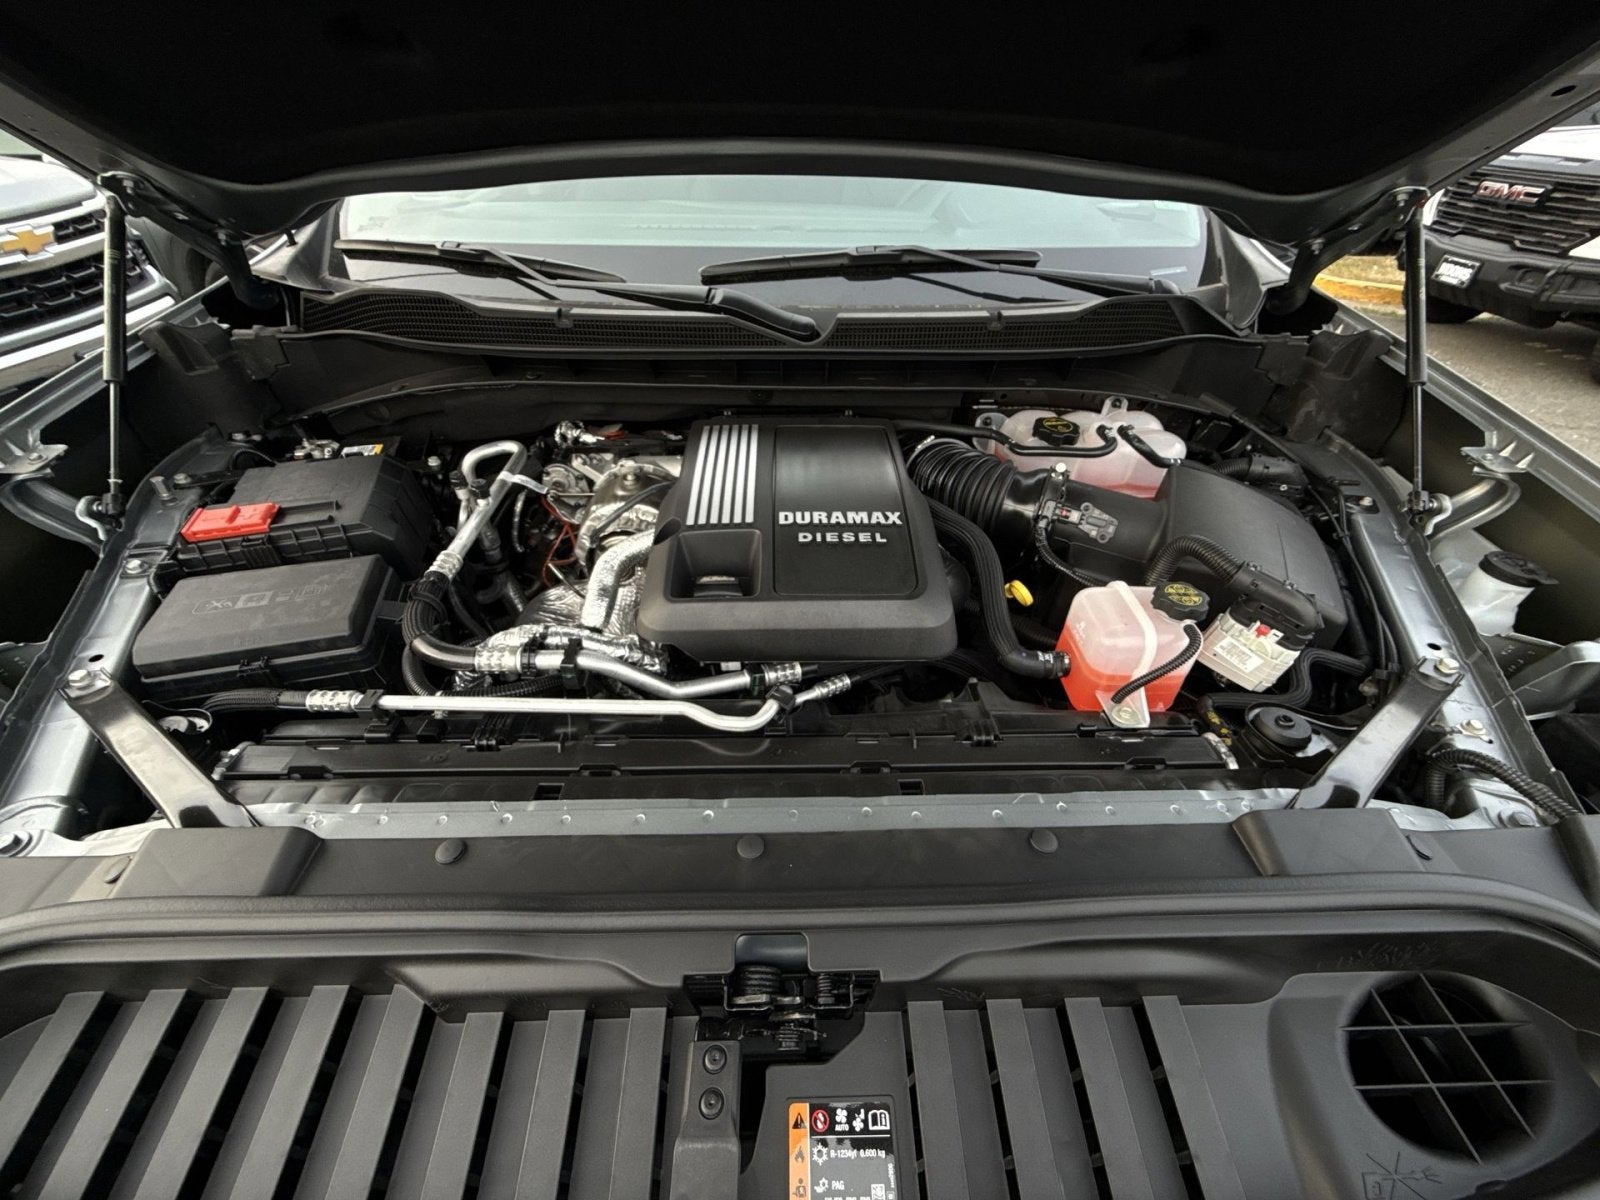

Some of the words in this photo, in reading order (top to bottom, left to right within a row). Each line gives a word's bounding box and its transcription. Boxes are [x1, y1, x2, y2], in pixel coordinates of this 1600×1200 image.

[1475, 181, 1546, 204] GMC
[779, 511, 903, 525] DURAMAX
[798, 532, 887, 542] DIESEL
[831, 1180, 845, 1190] PAG
